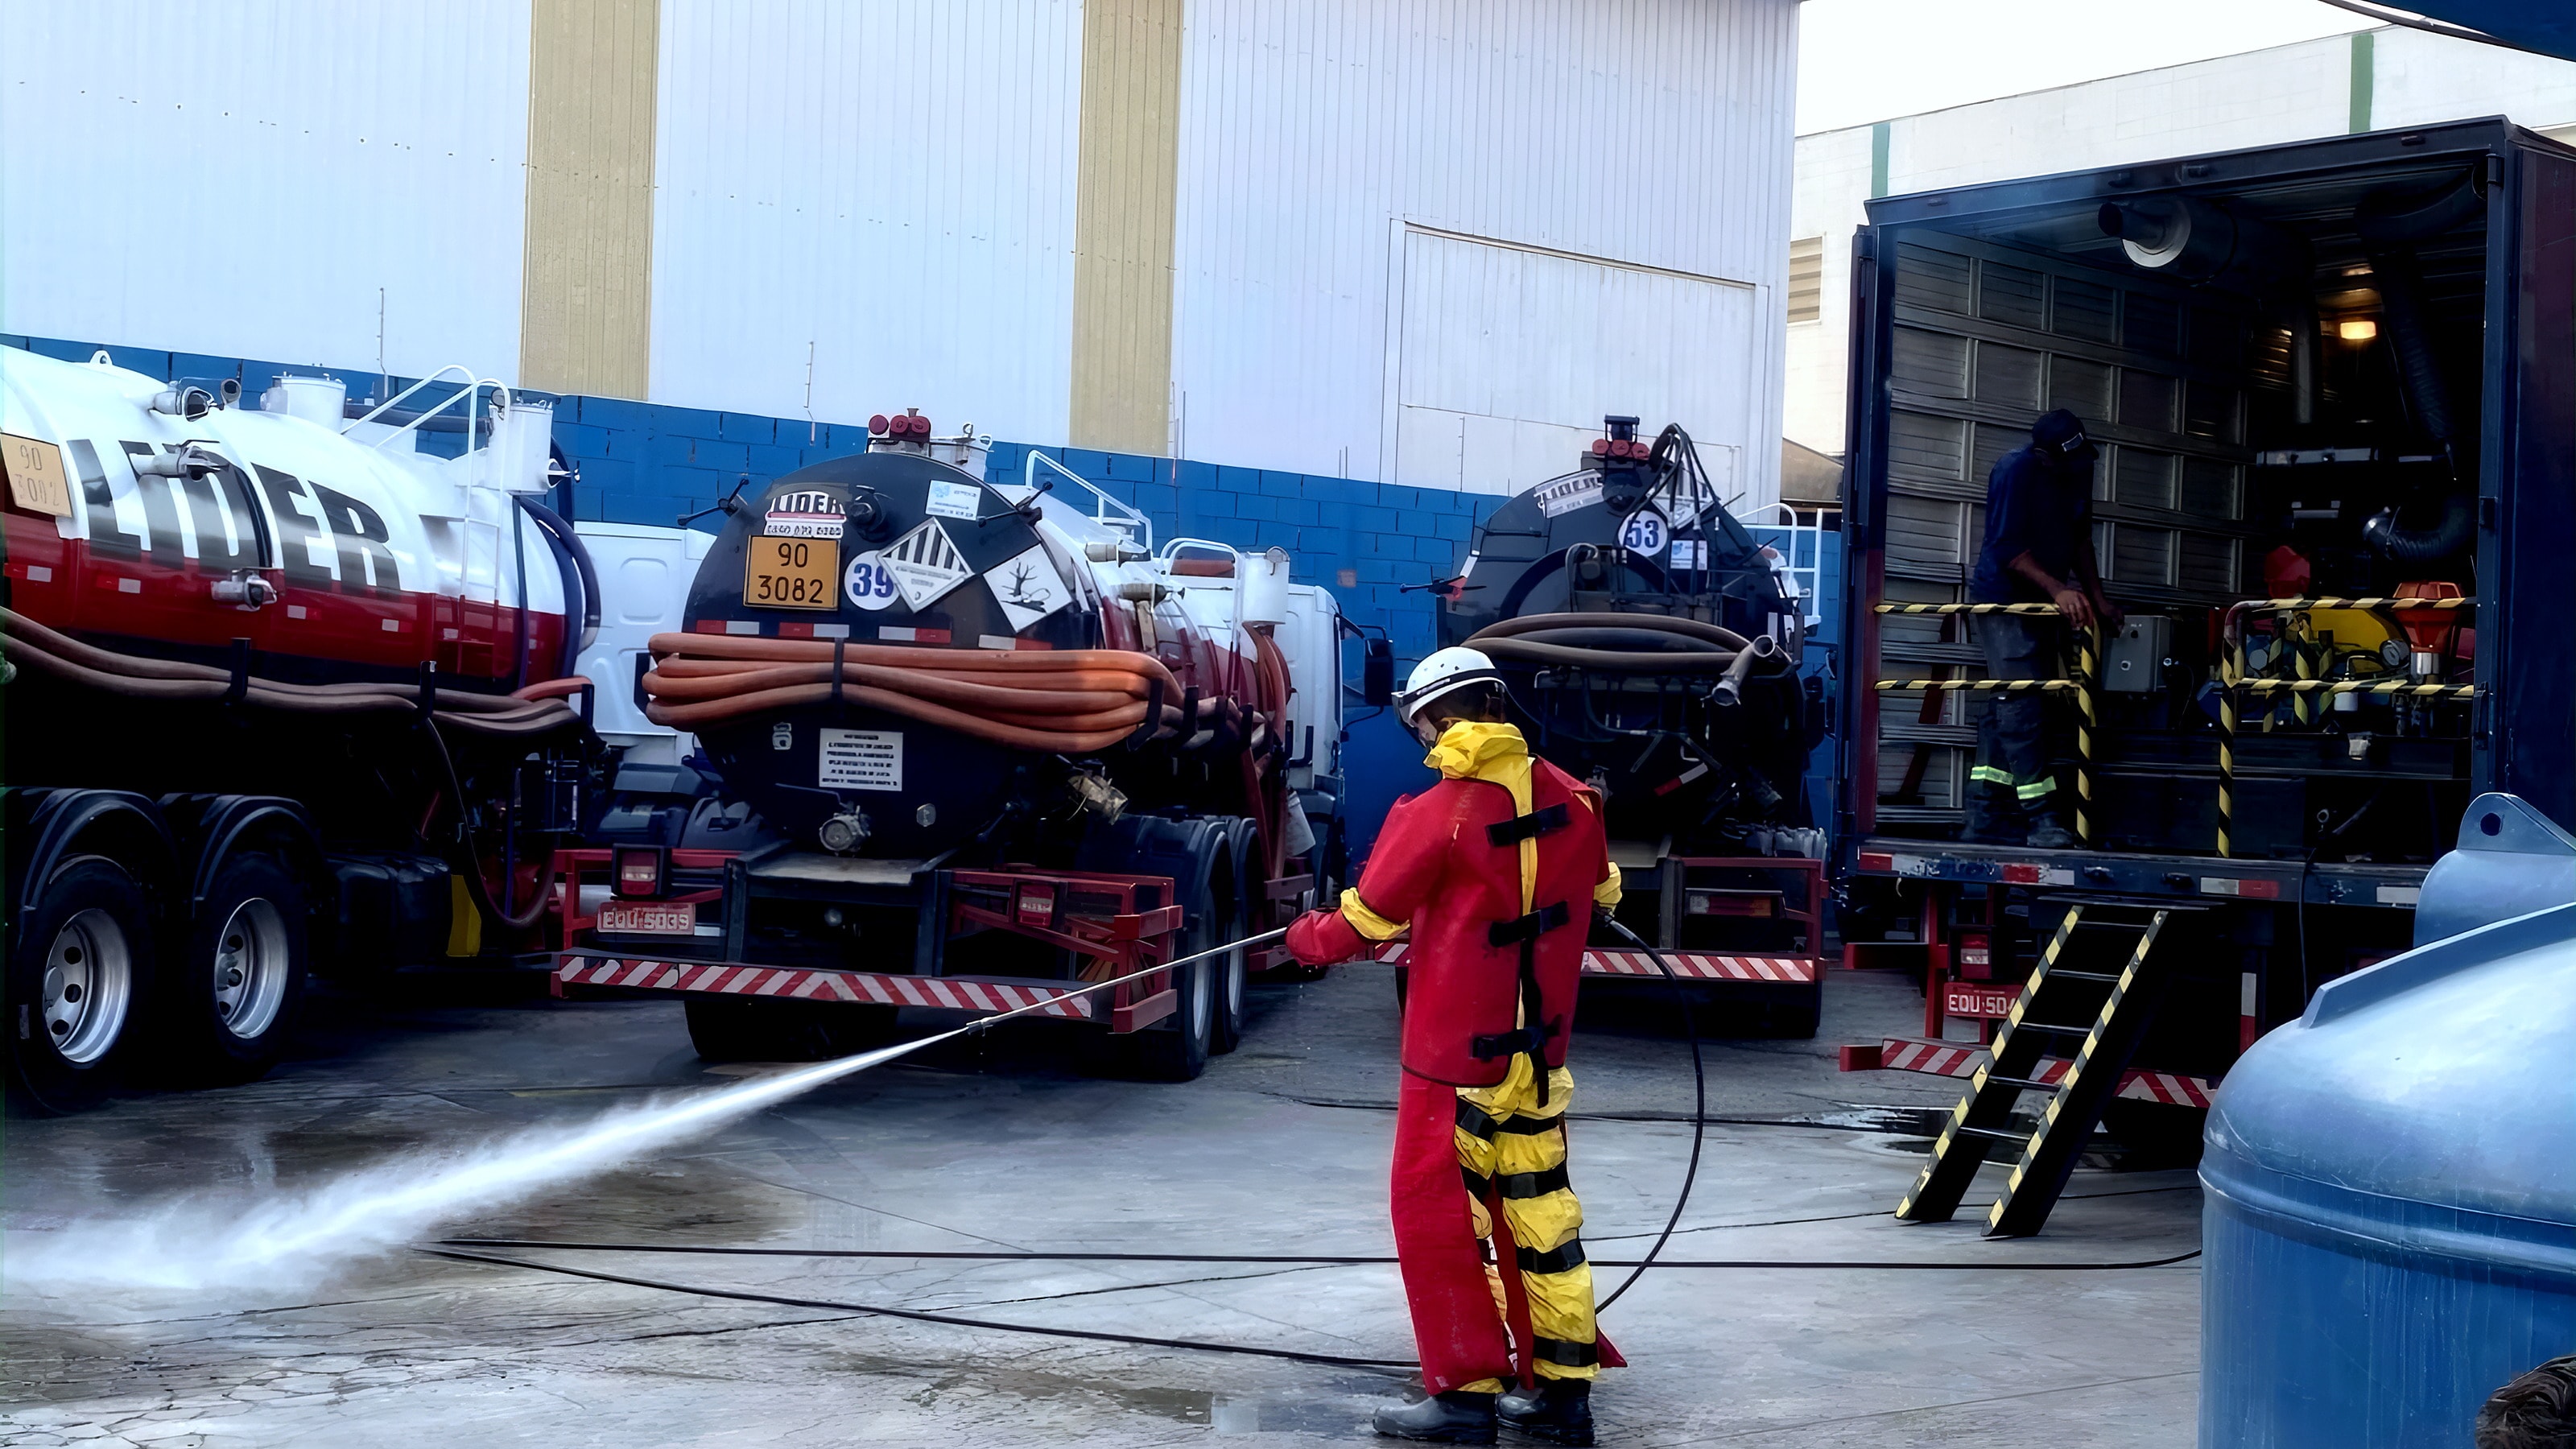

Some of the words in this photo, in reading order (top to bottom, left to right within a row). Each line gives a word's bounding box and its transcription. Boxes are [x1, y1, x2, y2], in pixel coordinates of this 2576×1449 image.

[19, 444, 43, 471] 90
[66, 439, 402, 597] LIDER
[773, 493, 842, 515] LIDER
[1624, 519, 1659, 549] 53
[777, 542, 809, 568] 90
[757, 574, 824, 604] 3082
[852, 563, 894, 599] 39
